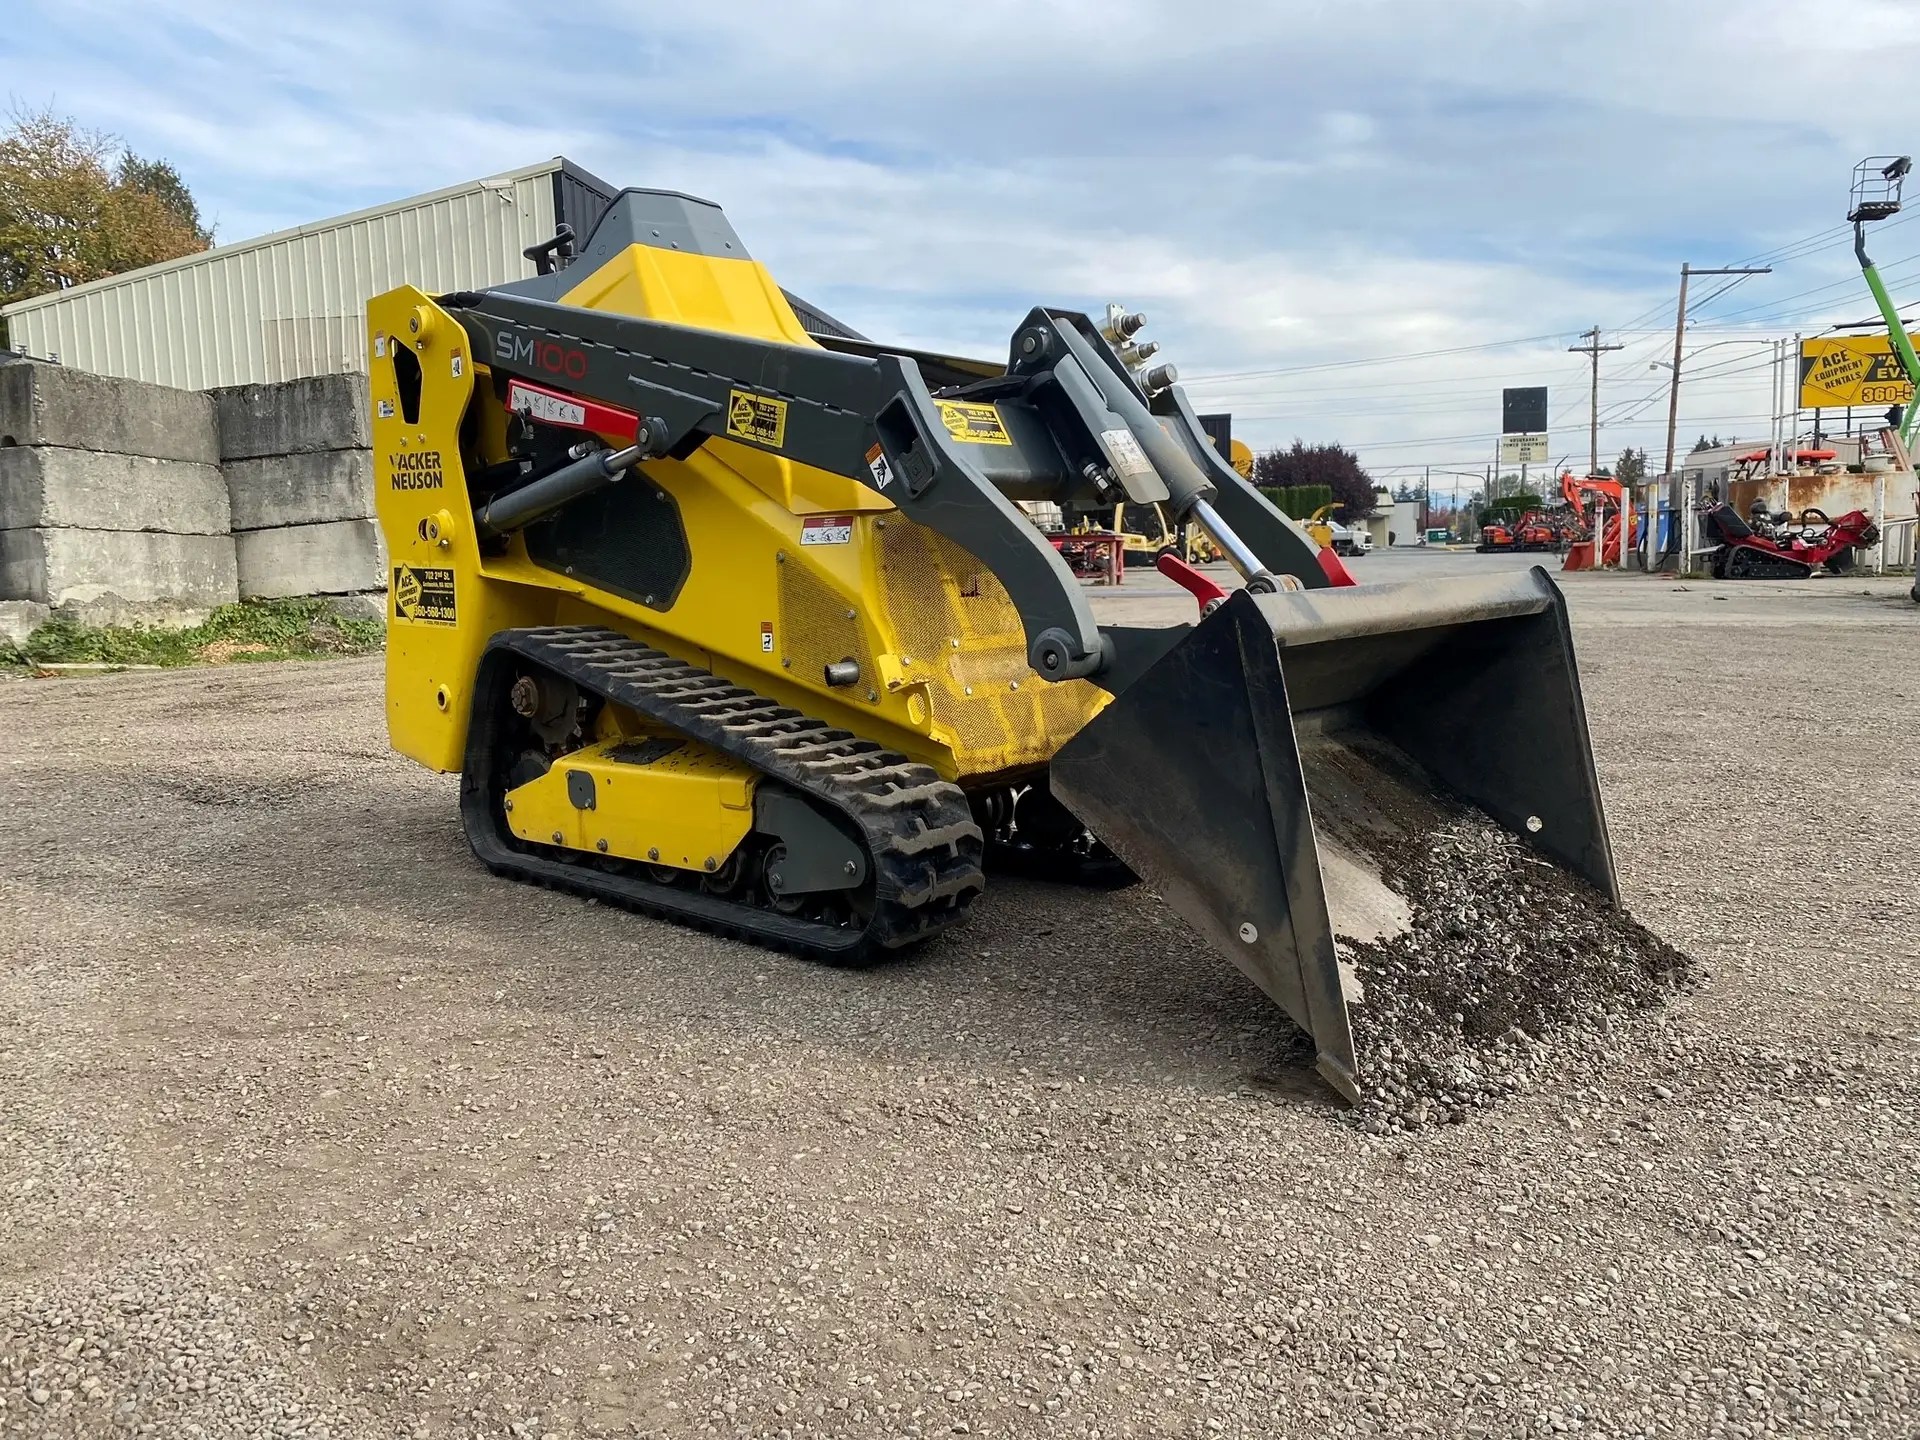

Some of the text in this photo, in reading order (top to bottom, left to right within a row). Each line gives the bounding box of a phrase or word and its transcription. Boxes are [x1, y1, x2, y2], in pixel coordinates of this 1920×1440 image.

[496, 331, 588, 379] SM100
[1822, 349, 1850, 368] ACE
[1814, 358, 1864, 382] EQUIPMENT
[1824, 371, 1862, 390] RENTALS
[391, 471, 443, 490] NEUSON
[402, 574, 413, 588] ACE
